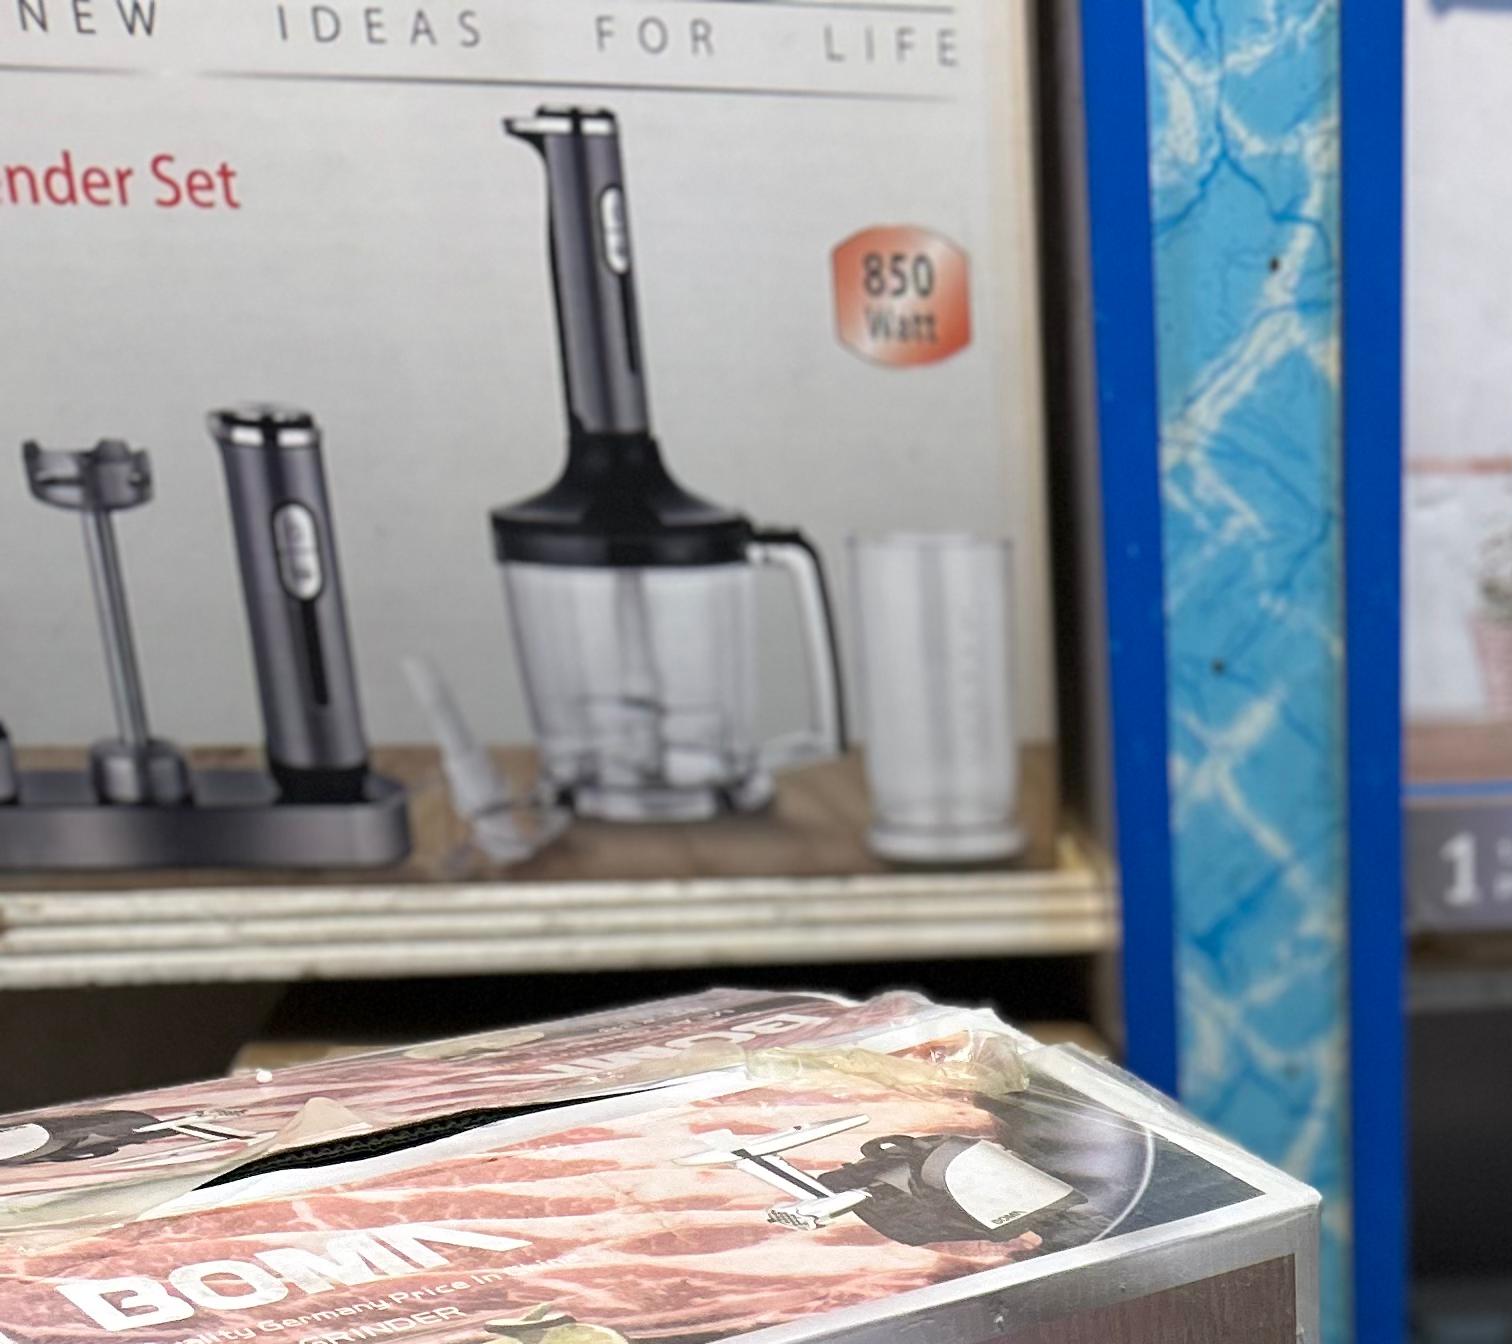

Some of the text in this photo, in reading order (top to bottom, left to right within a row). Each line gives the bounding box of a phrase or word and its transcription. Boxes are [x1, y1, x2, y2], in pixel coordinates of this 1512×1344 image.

[17, 0, 960, 68] NEW IDEAS FOR LIFE
[0, 149, 241, 210] nder Set
[863, 251, 935, 298] 850
[863, 302, 939, 345] Watt
[1440, 833, 1479, 903] 1
[56, 1221, 532, 1331] BOMA
[257, 1296, 393, 1334] Germany
[392, 1278, 486, 1306] Price
